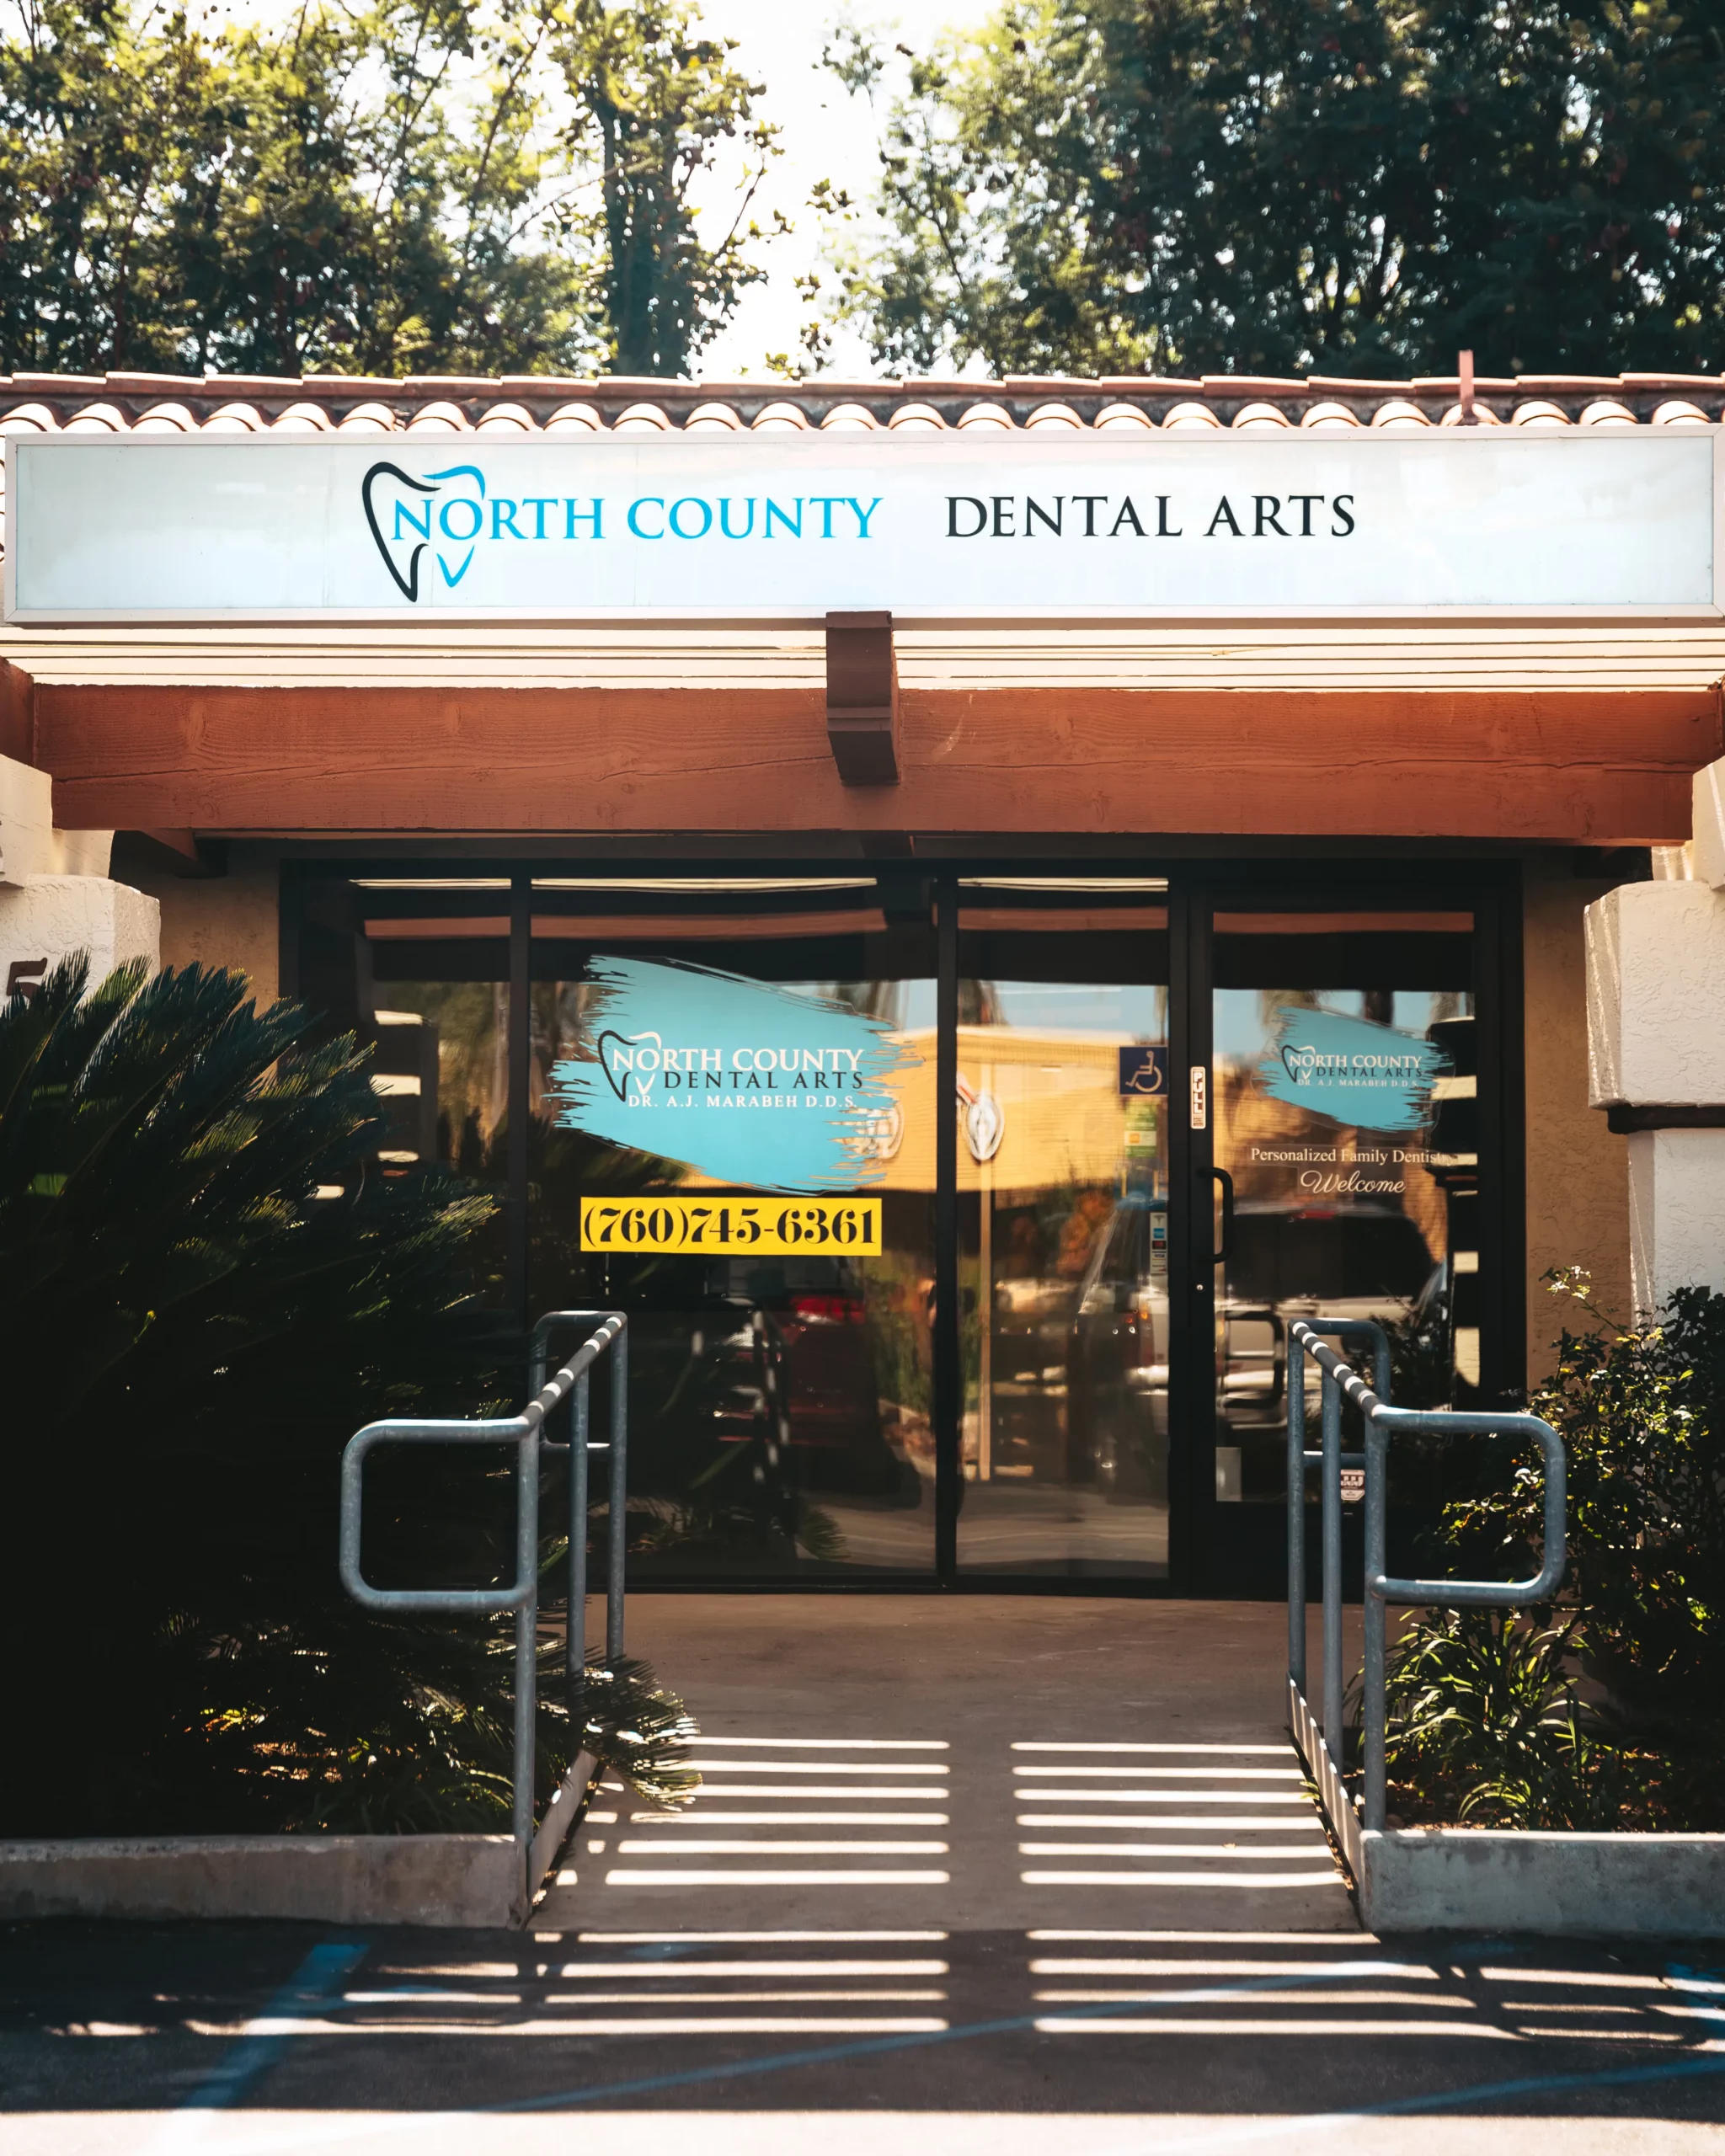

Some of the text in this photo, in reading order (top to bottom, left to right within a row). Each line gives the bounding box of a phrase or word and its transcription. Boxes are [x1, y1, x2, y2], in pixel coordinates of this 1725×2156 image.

[392, 495, 1356, 541] NORTH COUNTY DENTAL ARTS
[611, 1049, 863, 1071] NORTH COUNTY
[1290, 1055, 1422, 1068] NORTH COUNTY
[664, 1071, 863, 1089] DENTAL ARTS
[1316, 1067, 1423, 1077] DENTAL ARTS
[1339, 1078, 1387, 1087] MARABEH
[628, 1095, 857, 1107] DR. A.J. MARABEH D.D.S.
[1194, 1072, 1203, 1113] PULL
[1251, 1148, 1337, 1163] Personalized
[1341, 1148, 1388, 1165] Family
[1300, 1171, 1406, 1193] Welcome
[585, 1207, 874, 1246] (760)745-6361
